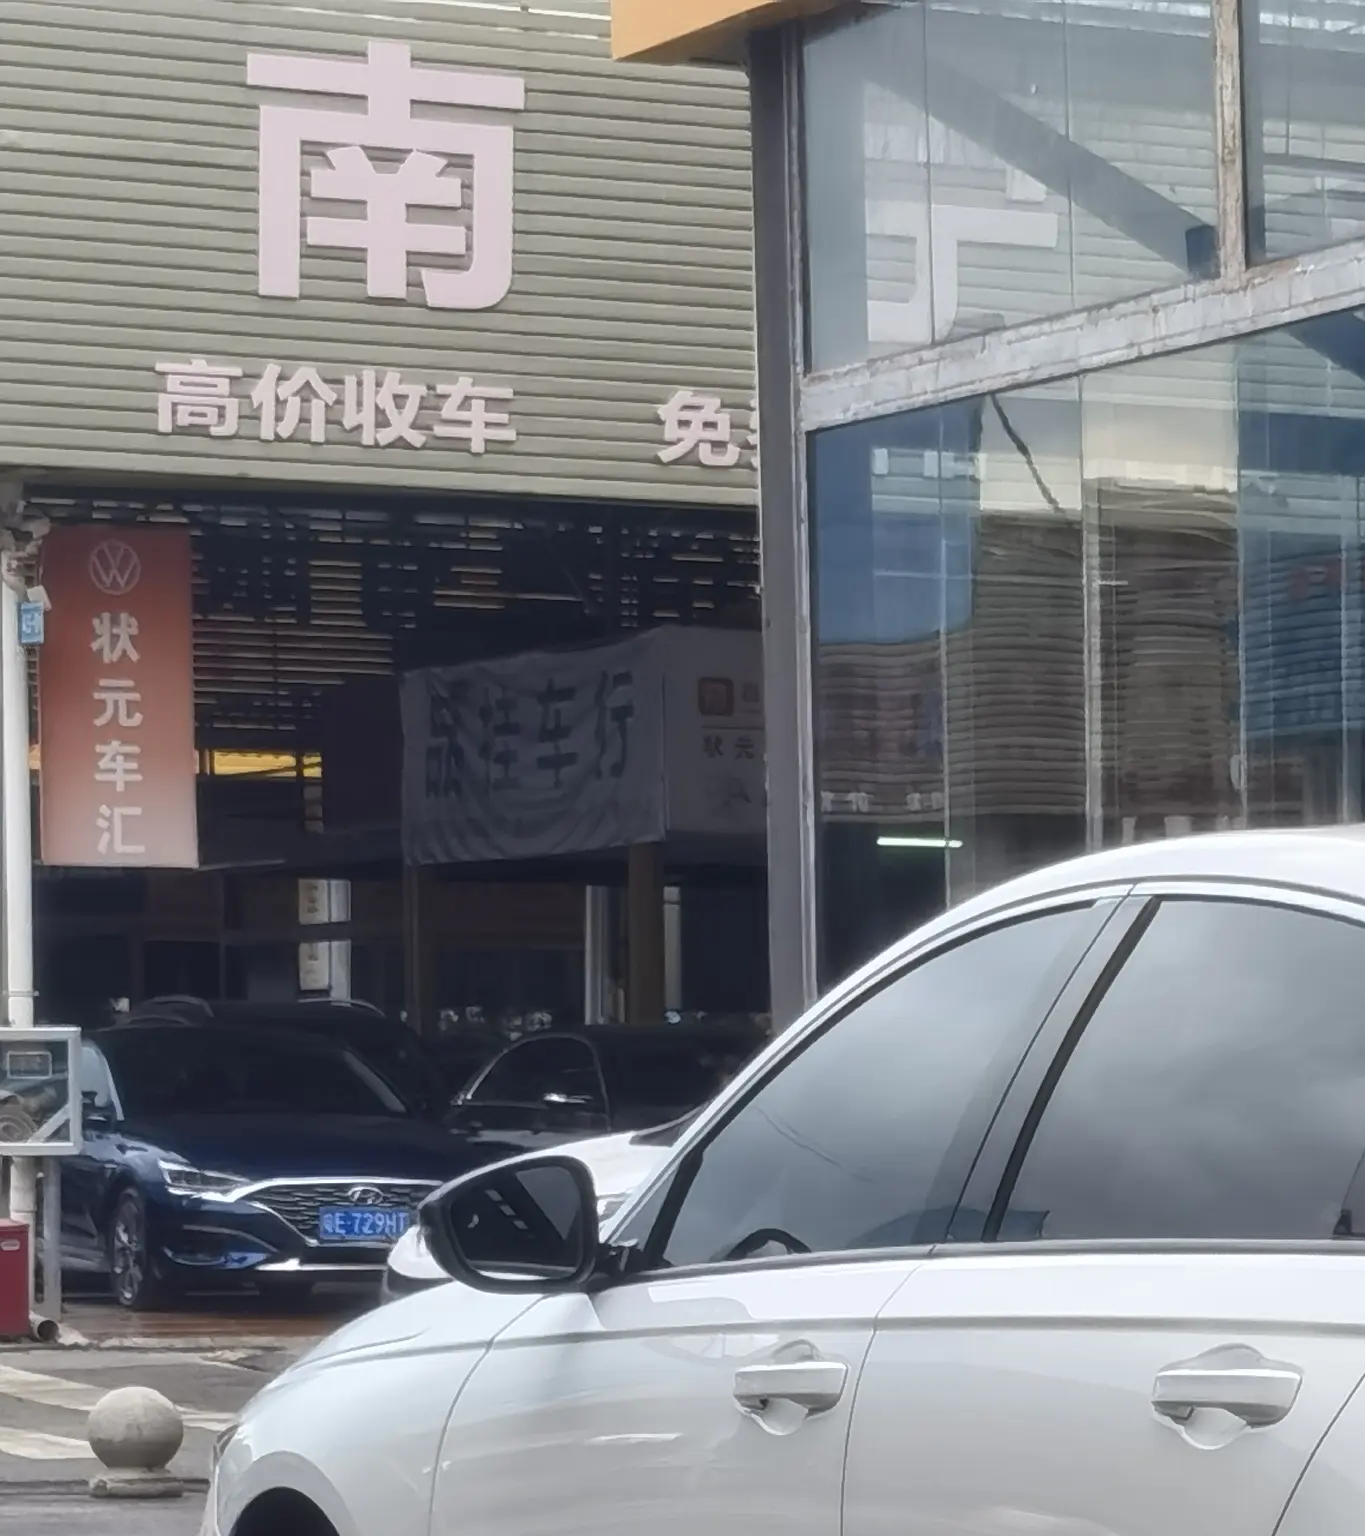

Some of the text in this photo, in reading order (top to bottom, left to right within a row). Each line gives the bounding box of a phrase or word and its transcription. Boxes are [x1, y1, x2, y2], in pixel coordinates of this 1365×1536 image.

[246, 41, 525, 309] 南
[155, 358, 758, 467] 高价收车 免
[91, 612, 146, 855] 状元车汇
